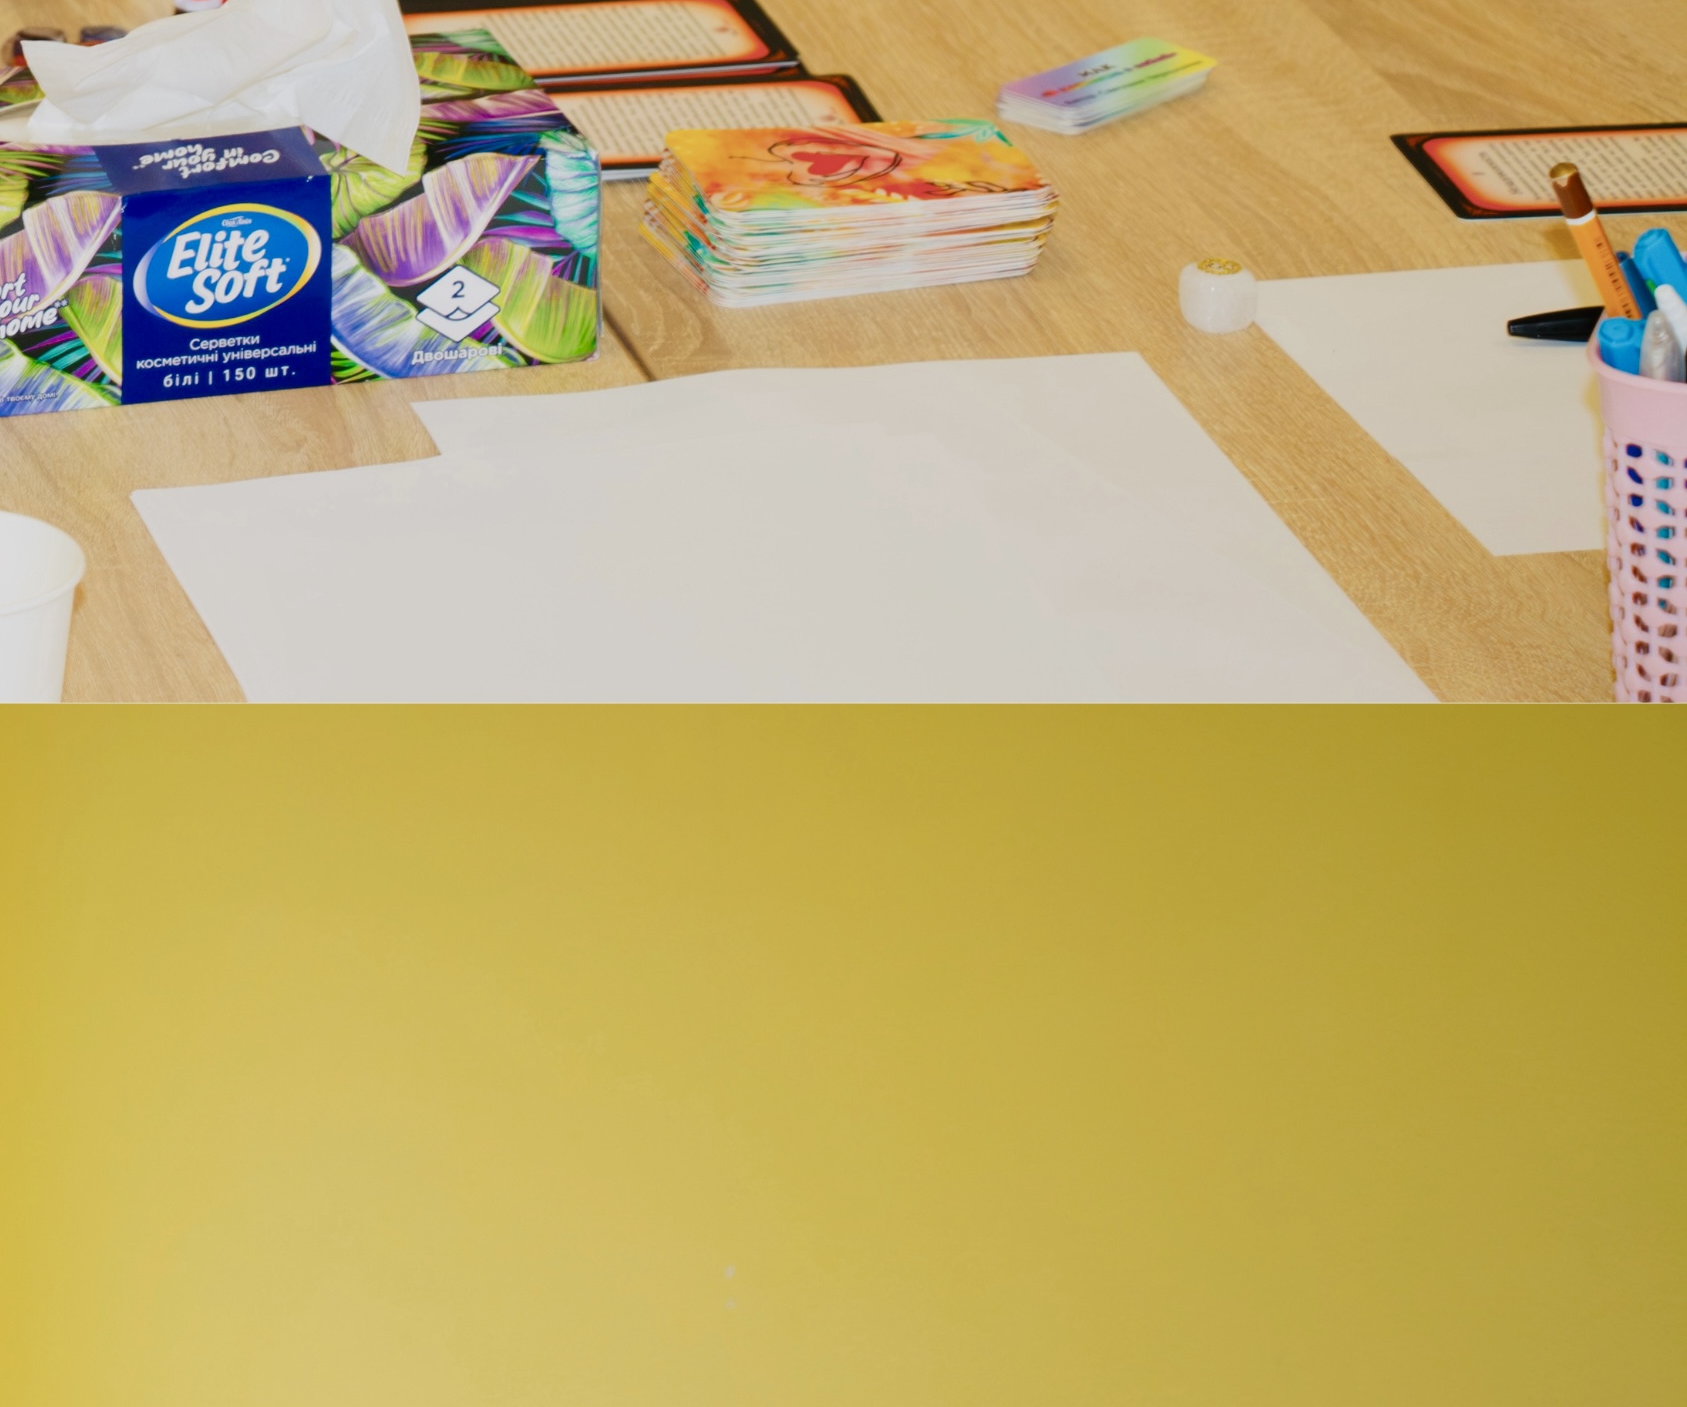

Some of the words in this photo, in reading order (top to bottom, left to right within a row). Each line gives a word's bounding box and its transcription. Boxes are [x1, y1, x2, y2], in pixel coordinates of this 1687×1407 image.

[162, 147, 217, 171] your
[178, 149, 282, 180] Comfort
[166, 229, 270, 280] Elite
[184, 257, 288, 315] Soft
[451, 280, 465, 299] 2
[136, 351, 219, 370] косметичні
[222, 341, 317, 364] універсальні
[189, 335, 261, 352] Серветки
[411, 342, 503, 365] Двошарові
[163, 372, 199, 388] білі
[223, 367, 257, 383] 150
[265, 365, 296, 379] шт.
